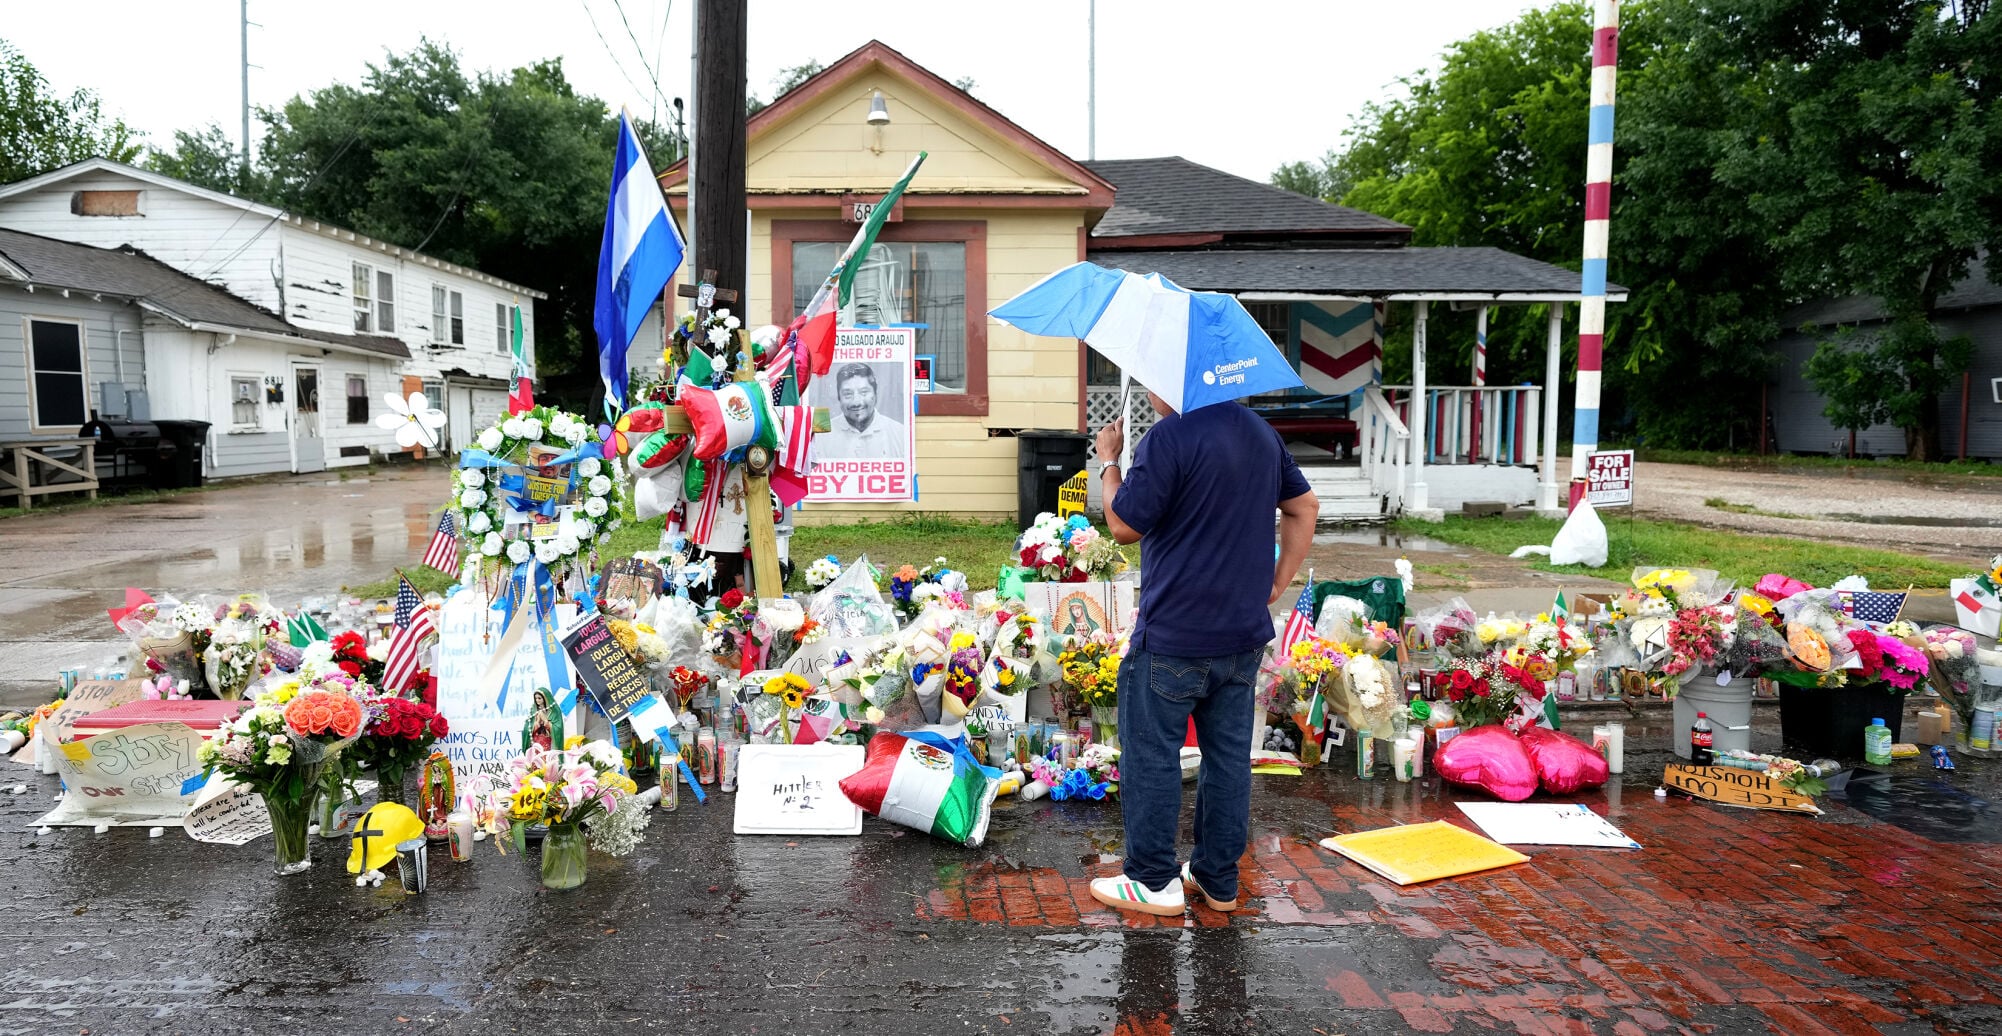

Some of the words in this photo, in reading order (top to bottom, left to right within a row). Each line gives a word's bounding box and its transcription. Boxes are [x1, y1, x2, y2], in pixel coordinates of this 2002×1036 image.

[855, 204, 889, 221] 68
[842, 334, 874, 346] SALGADO
[875, 334, 905, 346] ARAUJO
[834, 348, 864, 359] THER
[866, 348, 882, 359] OF
[885, 348, 893, 359] 3
[1215, 357, 1258, 374] CenterPoint
[1219, 373, 1245, 385] Energy
[1595, 456, 1624, 469] FOR
[1589, 467, 1630, 482] SALE
[810, 475, 848, 494] BY
[858, 475, 906, 494] ICE
[1592, 482, 1601, 491] BY
[1602, 481, 1626, 490] OWNER
[531, 491, 560, 503] LOREO
[574, 628, 611, 655] LARGUE
[595, 649, 626, 672] LARGU
[601, 662, 626, 681] TODO
[606, 667, 639, 692] RÉGIME
[74, 685, 115, 700] STOP
[610, 676, 643, 702] FASCIS
[608, 704, 623, 717] DE
[433, 731, 488, 745] NIMOS
[494, 730, 512, 745] HA
[92, 735, 190, 775] Story
[1675, 776, 1718, 797] OUT
[1729, 788, 1796, 807] ICE
[193, 817, 206, 828] will
